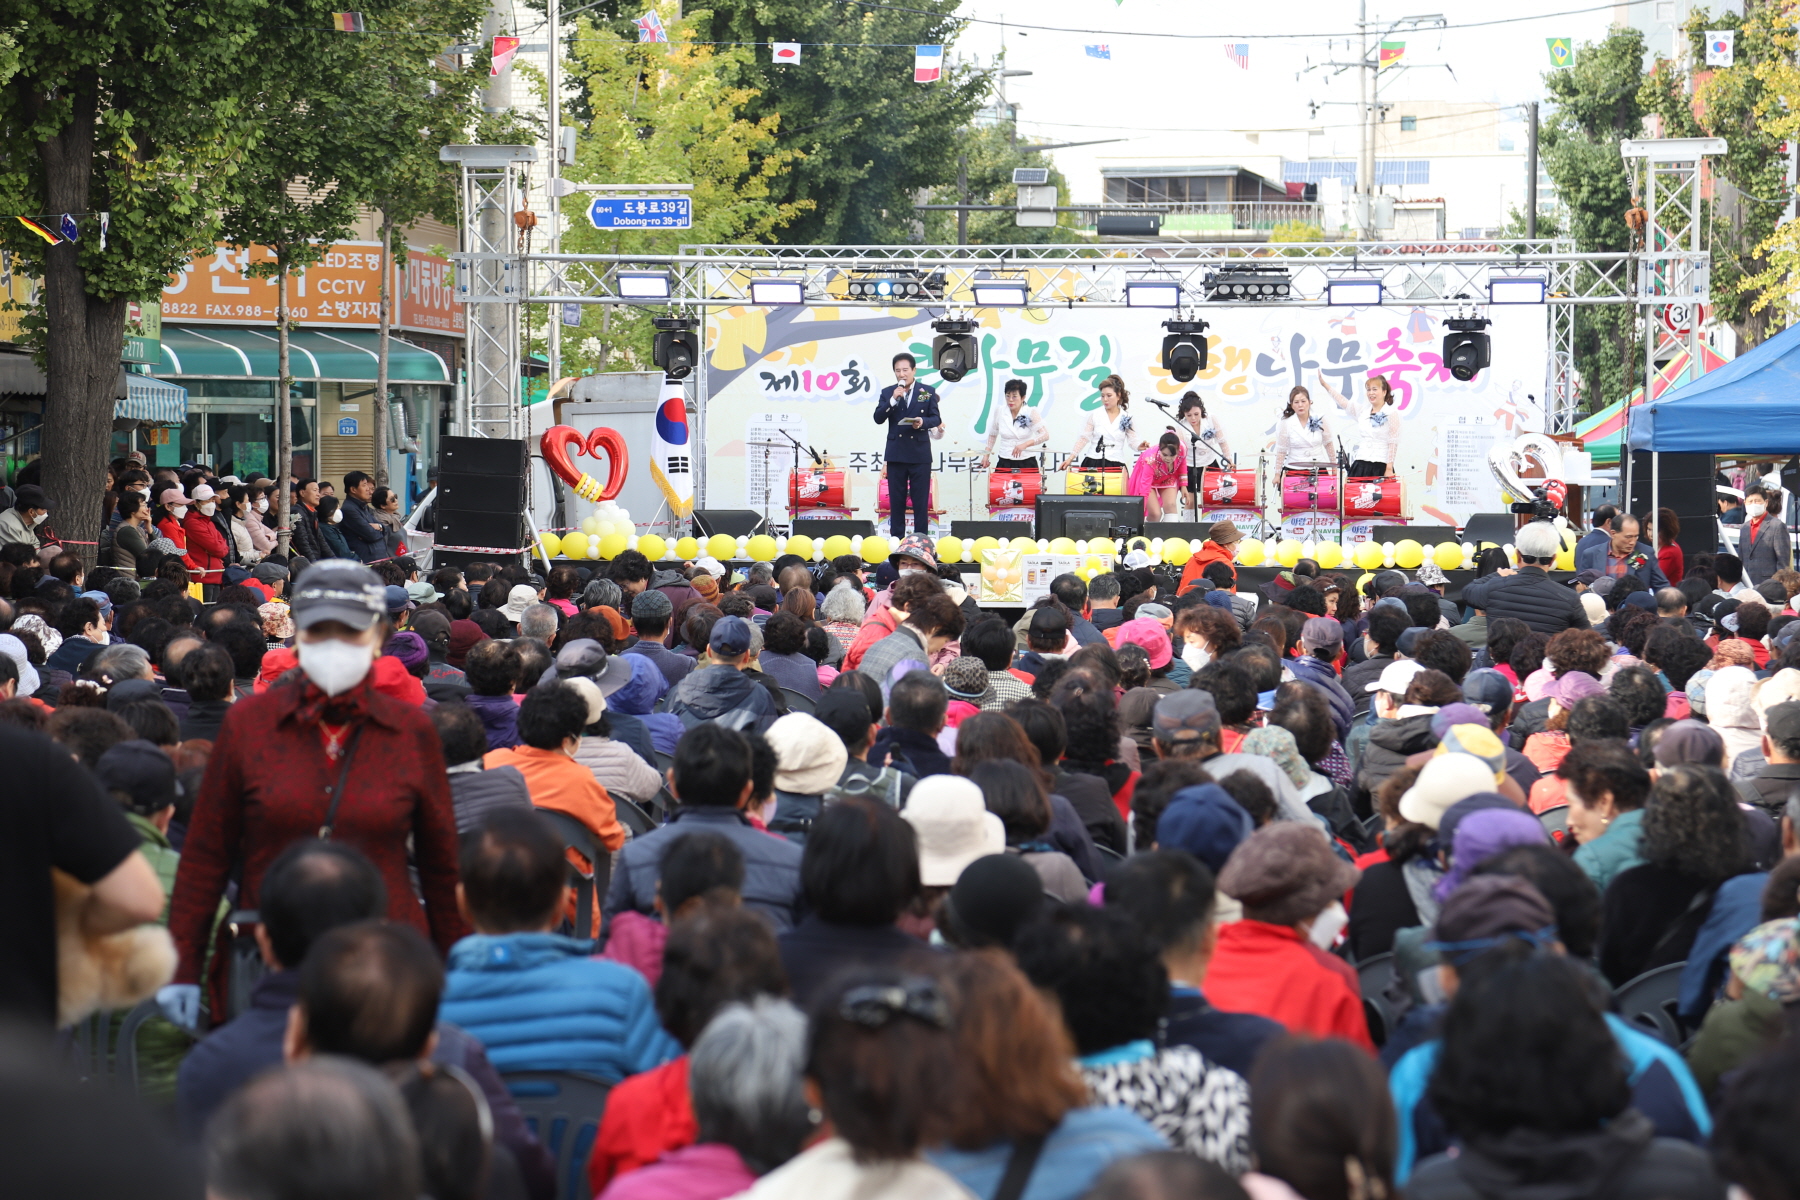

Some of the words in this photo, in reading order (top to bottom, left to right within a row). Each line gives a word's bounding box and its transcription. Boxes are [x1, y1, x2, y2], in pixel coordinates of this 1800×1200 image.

[622, 201, 688, 215] 도봉로39길
[613, 217, 661, 226] Dobong-ro
[662, 217, 688, 226] 39-gil
[317, 253, 380, 271] LED조명
[317, 279, 366, 295] CCTV
[122, 340, 144, 358] -2778
[759, 359, 871, 396] 제10회
